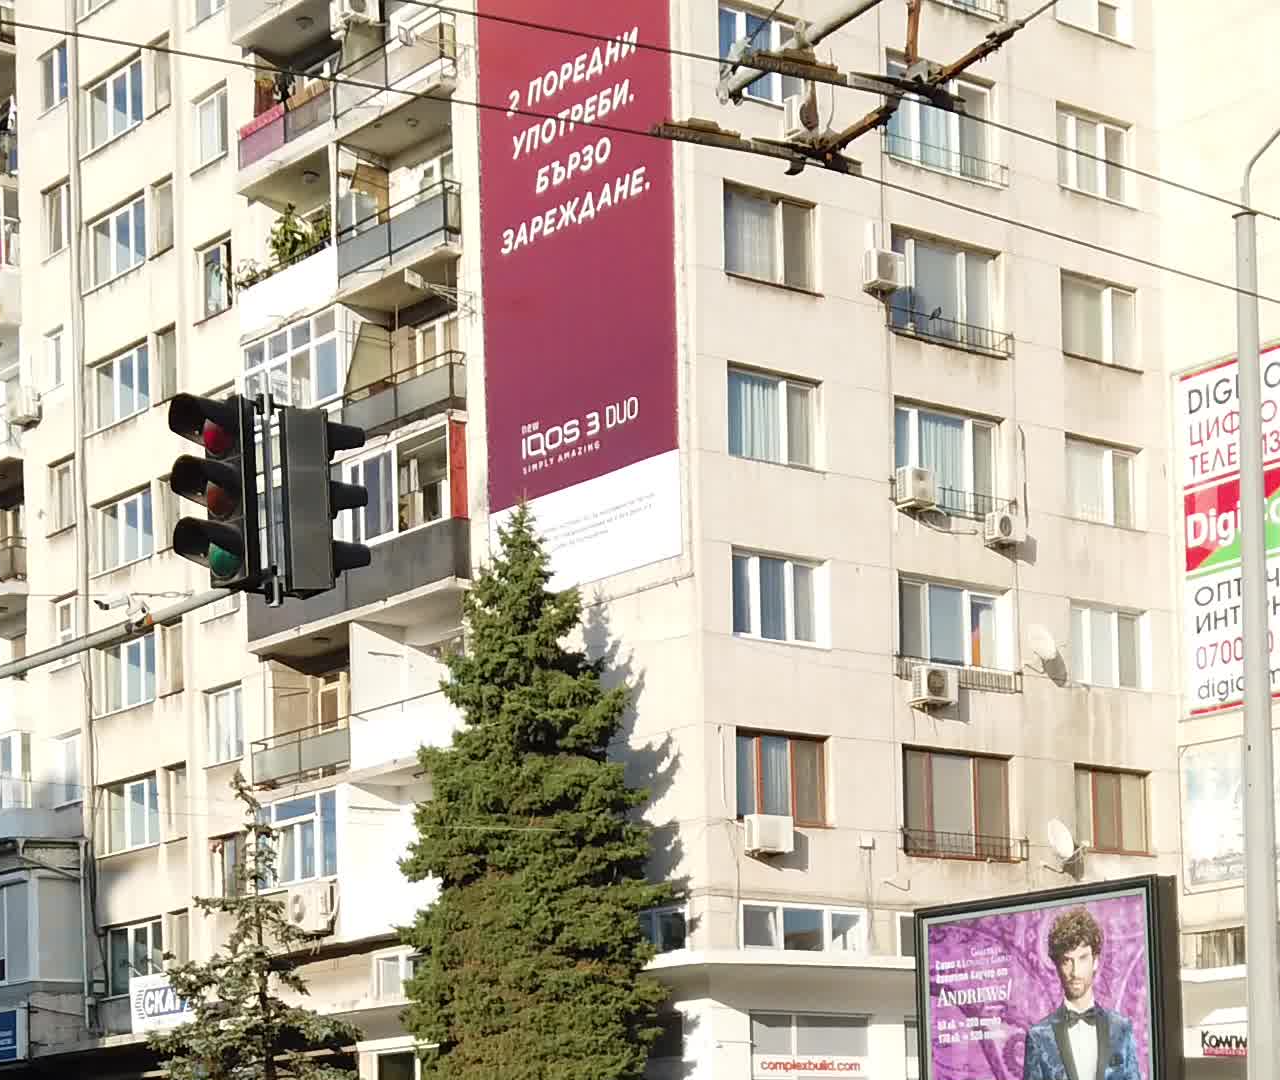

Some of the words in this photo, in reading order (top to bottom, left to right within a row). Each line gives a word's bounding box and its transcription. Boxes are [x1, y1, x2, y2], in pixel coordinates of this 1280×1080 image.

[506, 90, 520, 117] 2
[527, 26, 638, 107] ПОРЕДНИ
[512, 78, 635, 161] УПОТРЕБИ.
[536, 137, 612, 195] БЪРЗО
[500, 166, 651, 256] ЗАРЕЖДАНЕ.
[521, 418, 580, 460] IQOS
[586, 411, 600, 436] 3
[606, 396, 639, 428] DUO
[522, 457, 554, 476] SIMPLY
[557, 440, 601, 463] AMAZING
[760, 1059, 861, 1073] complexbuild.com
